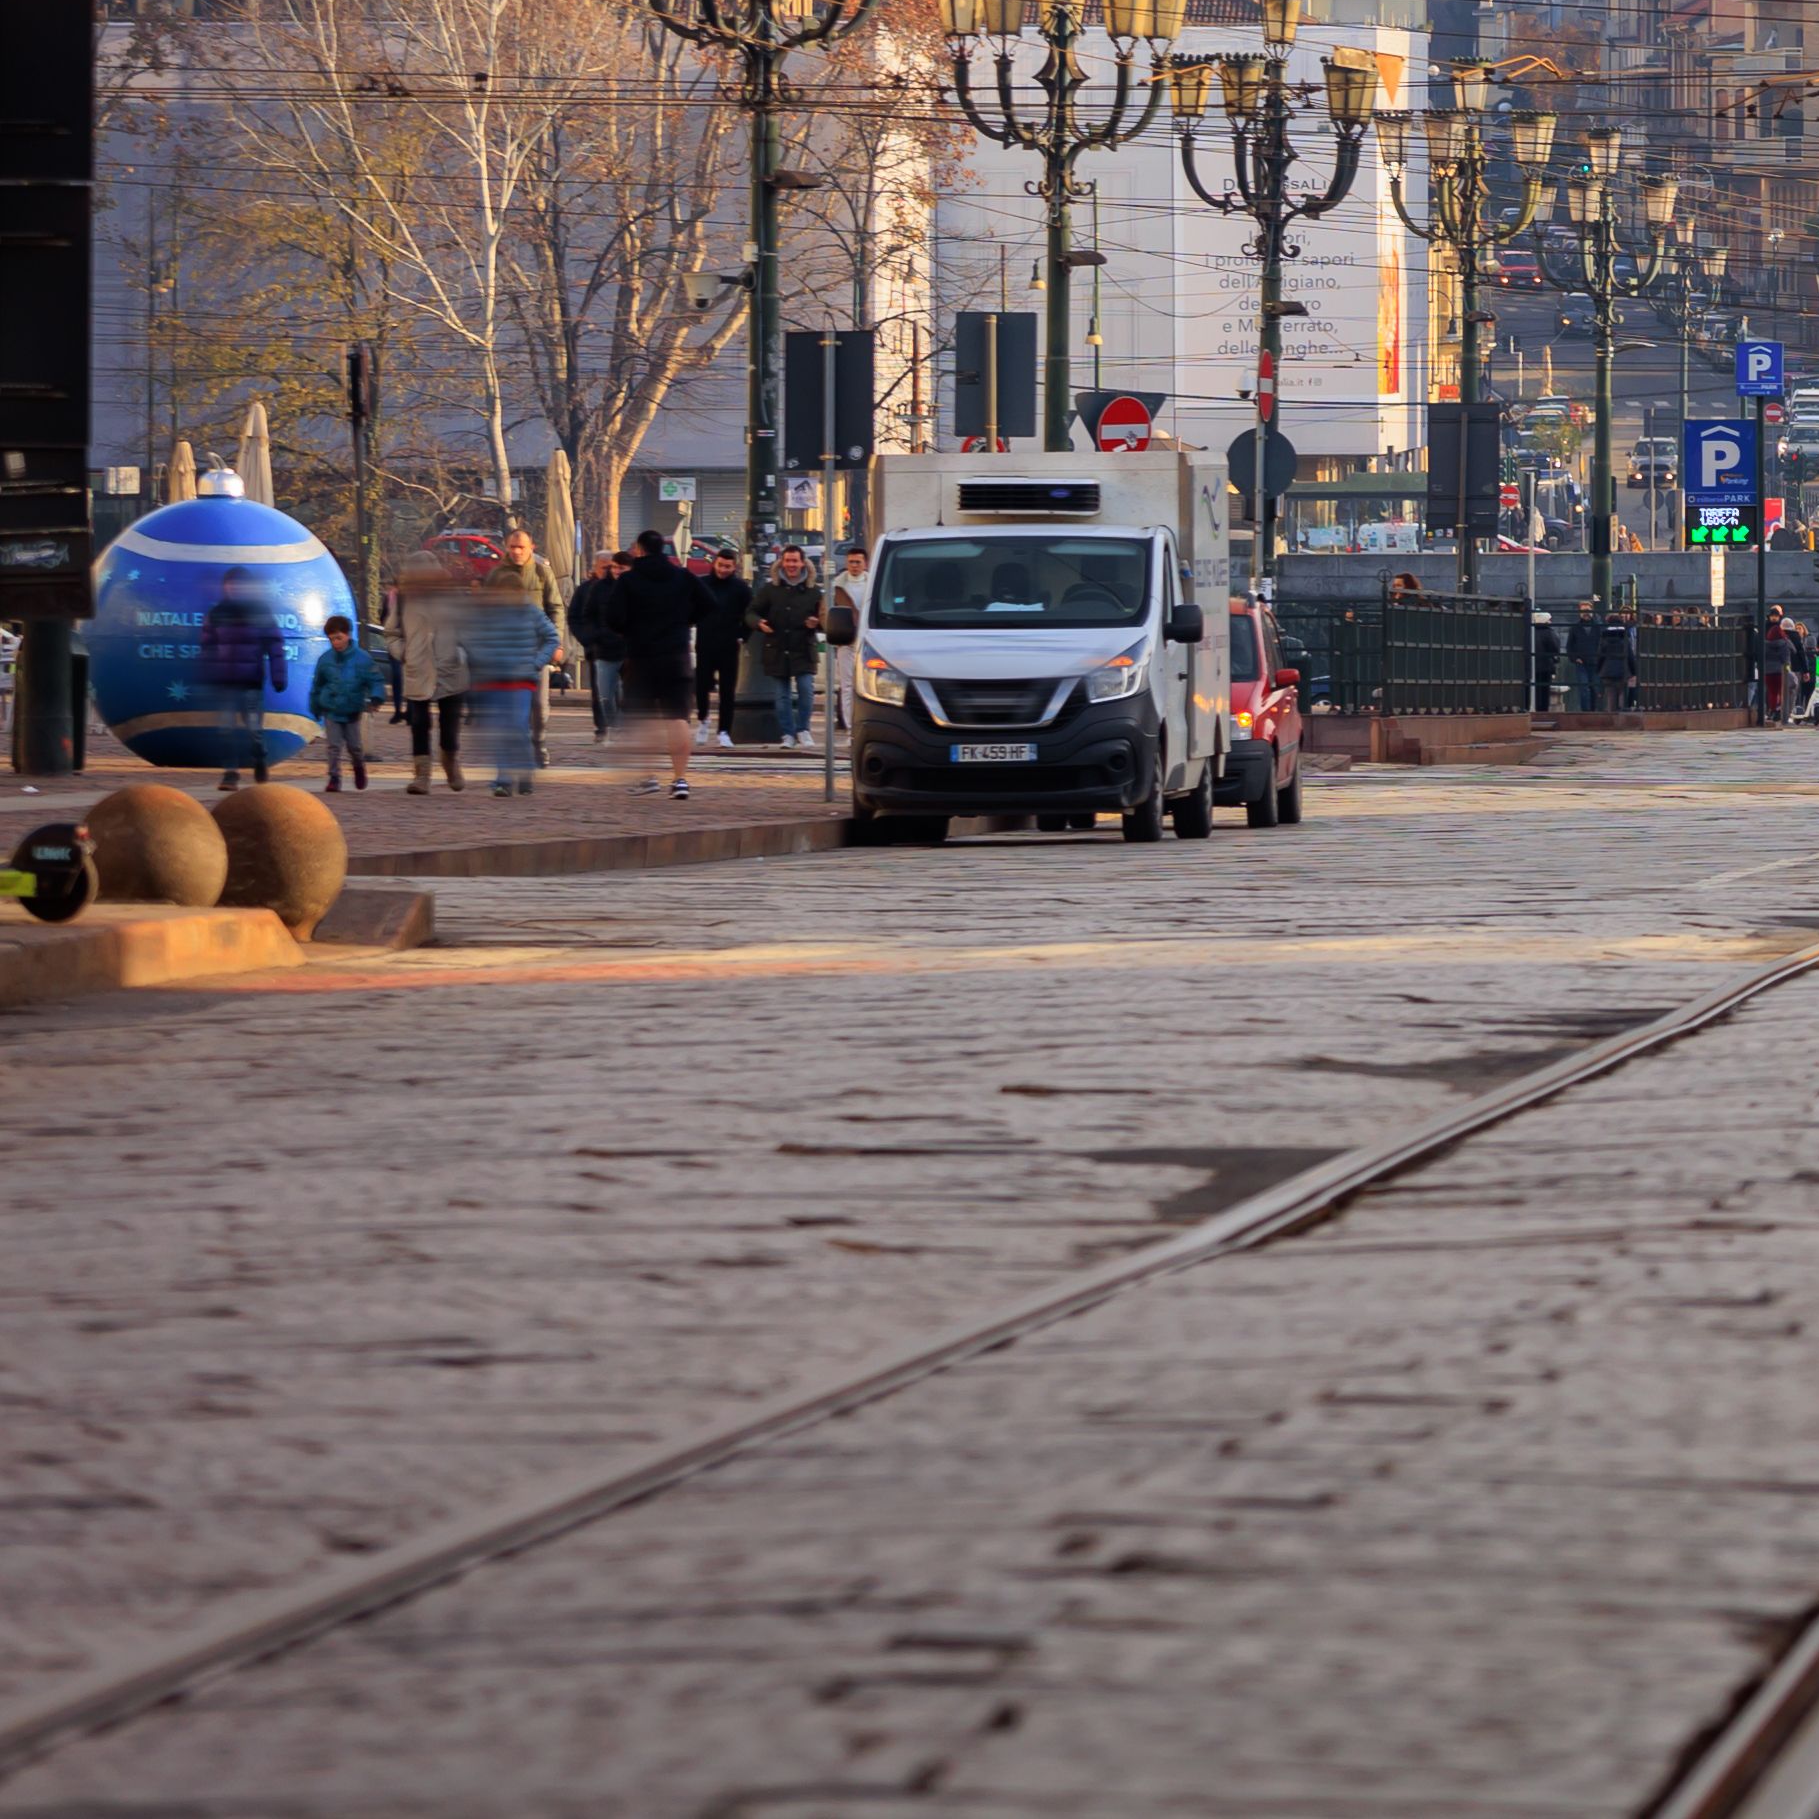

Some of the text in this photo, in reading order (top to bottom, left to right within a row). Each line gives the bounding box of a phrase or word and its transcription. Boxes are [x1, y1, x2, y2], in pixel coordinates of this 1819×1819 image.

[1222, 322, 1233, 333] e
[1748, 353, 1772, 381] P
[1701, 440, 1741, 487] P
[1699, 507, 1740, 517] TARIFFA
[136, 611, 204, 627] NATALE
[138, 644, 175, 659] CHE
